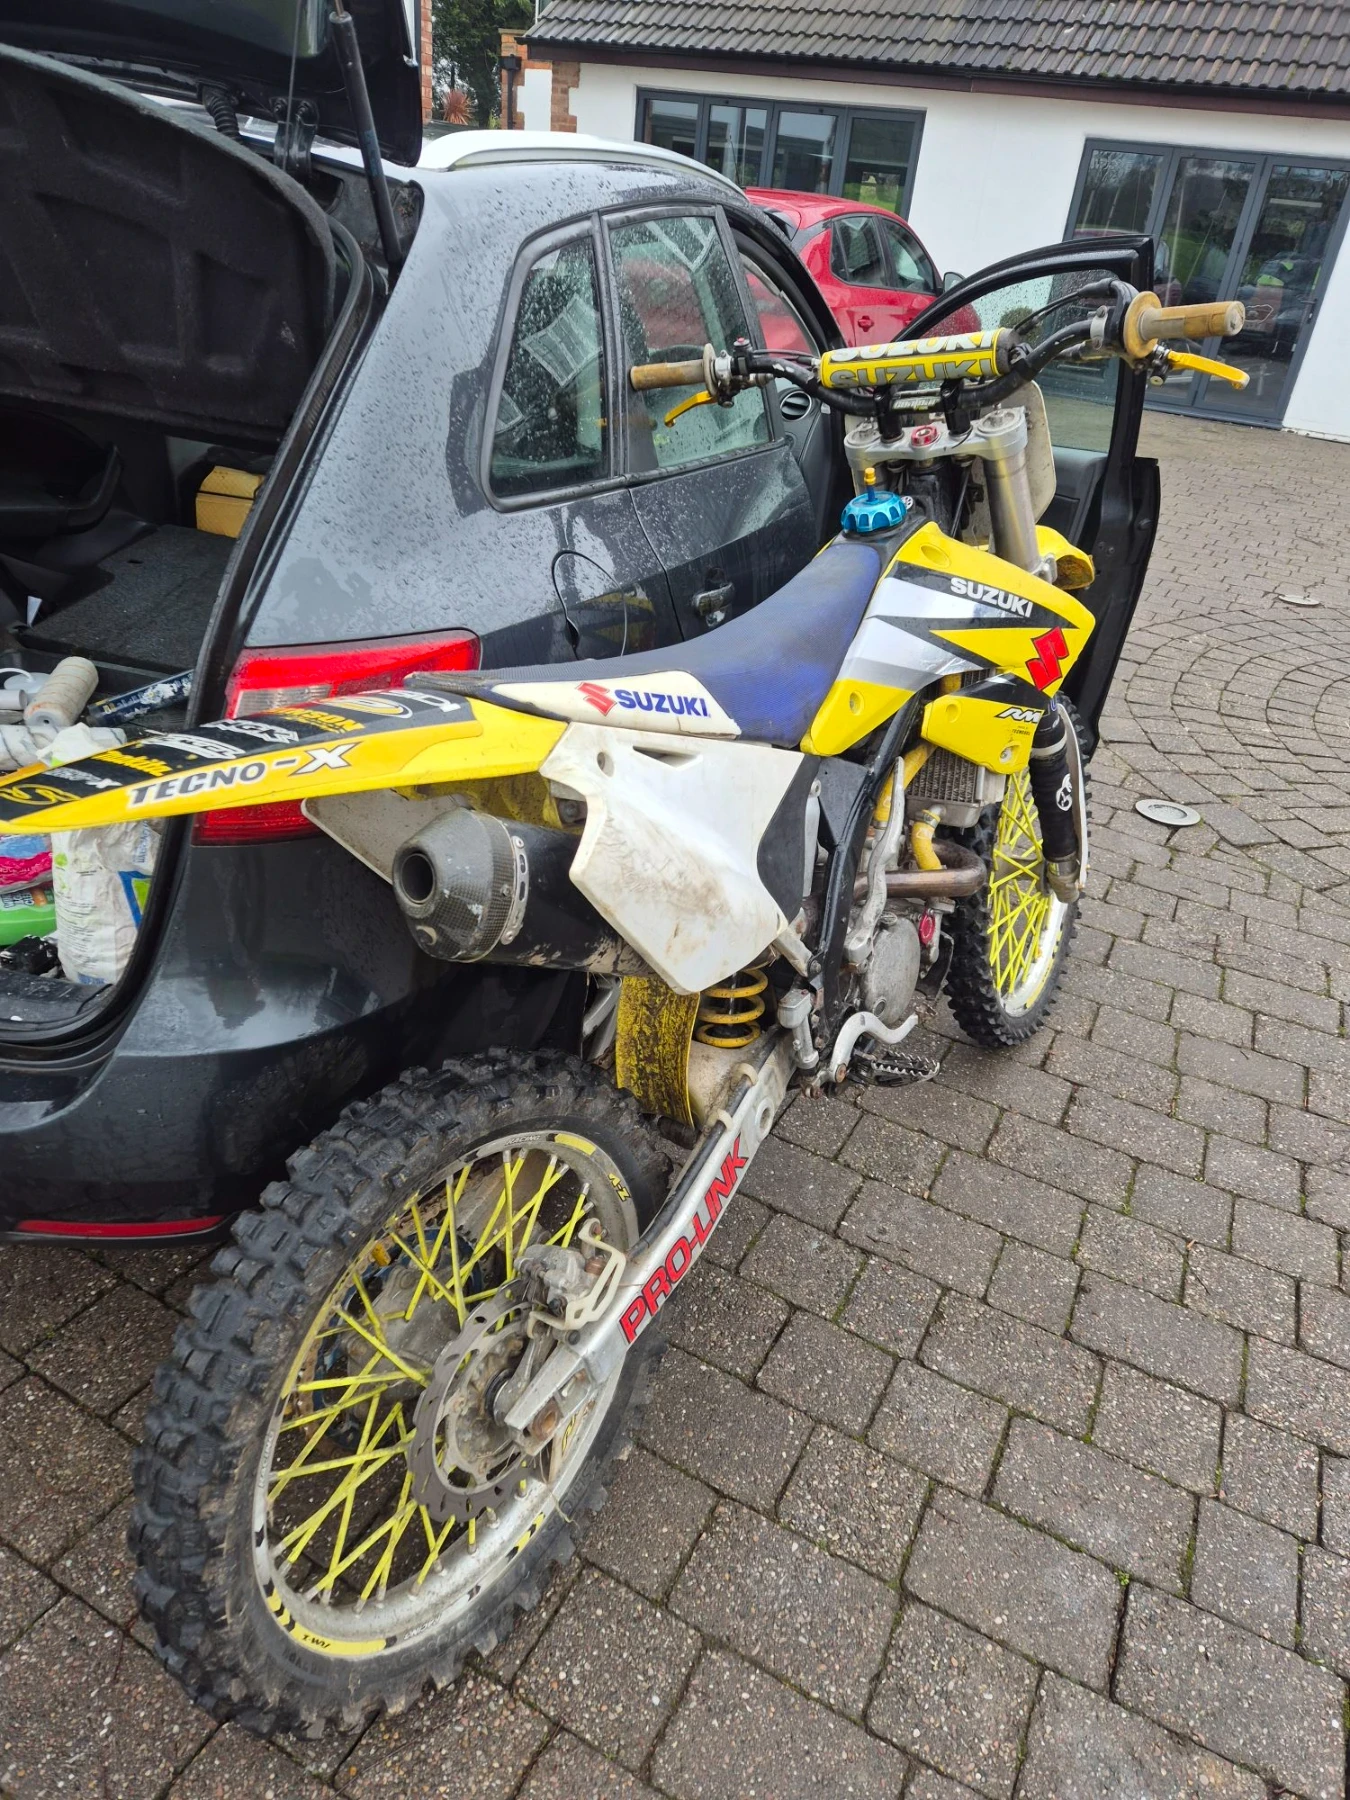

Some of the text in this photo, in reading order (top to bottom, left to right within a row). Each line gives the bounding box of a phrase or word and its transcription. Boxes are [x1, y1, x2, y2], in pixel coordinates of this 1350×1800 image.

[829, 358, 994, 388] SUZUKI
[950, 577, 1034, 618] SUZUKI
[614, 689, 709, 717] SUZUKI
[995, 706, 1042, 724] RM
[127, 741, 362, 809] TECNO-X
[619, 1134, 748, 1344] PRO-LINK
